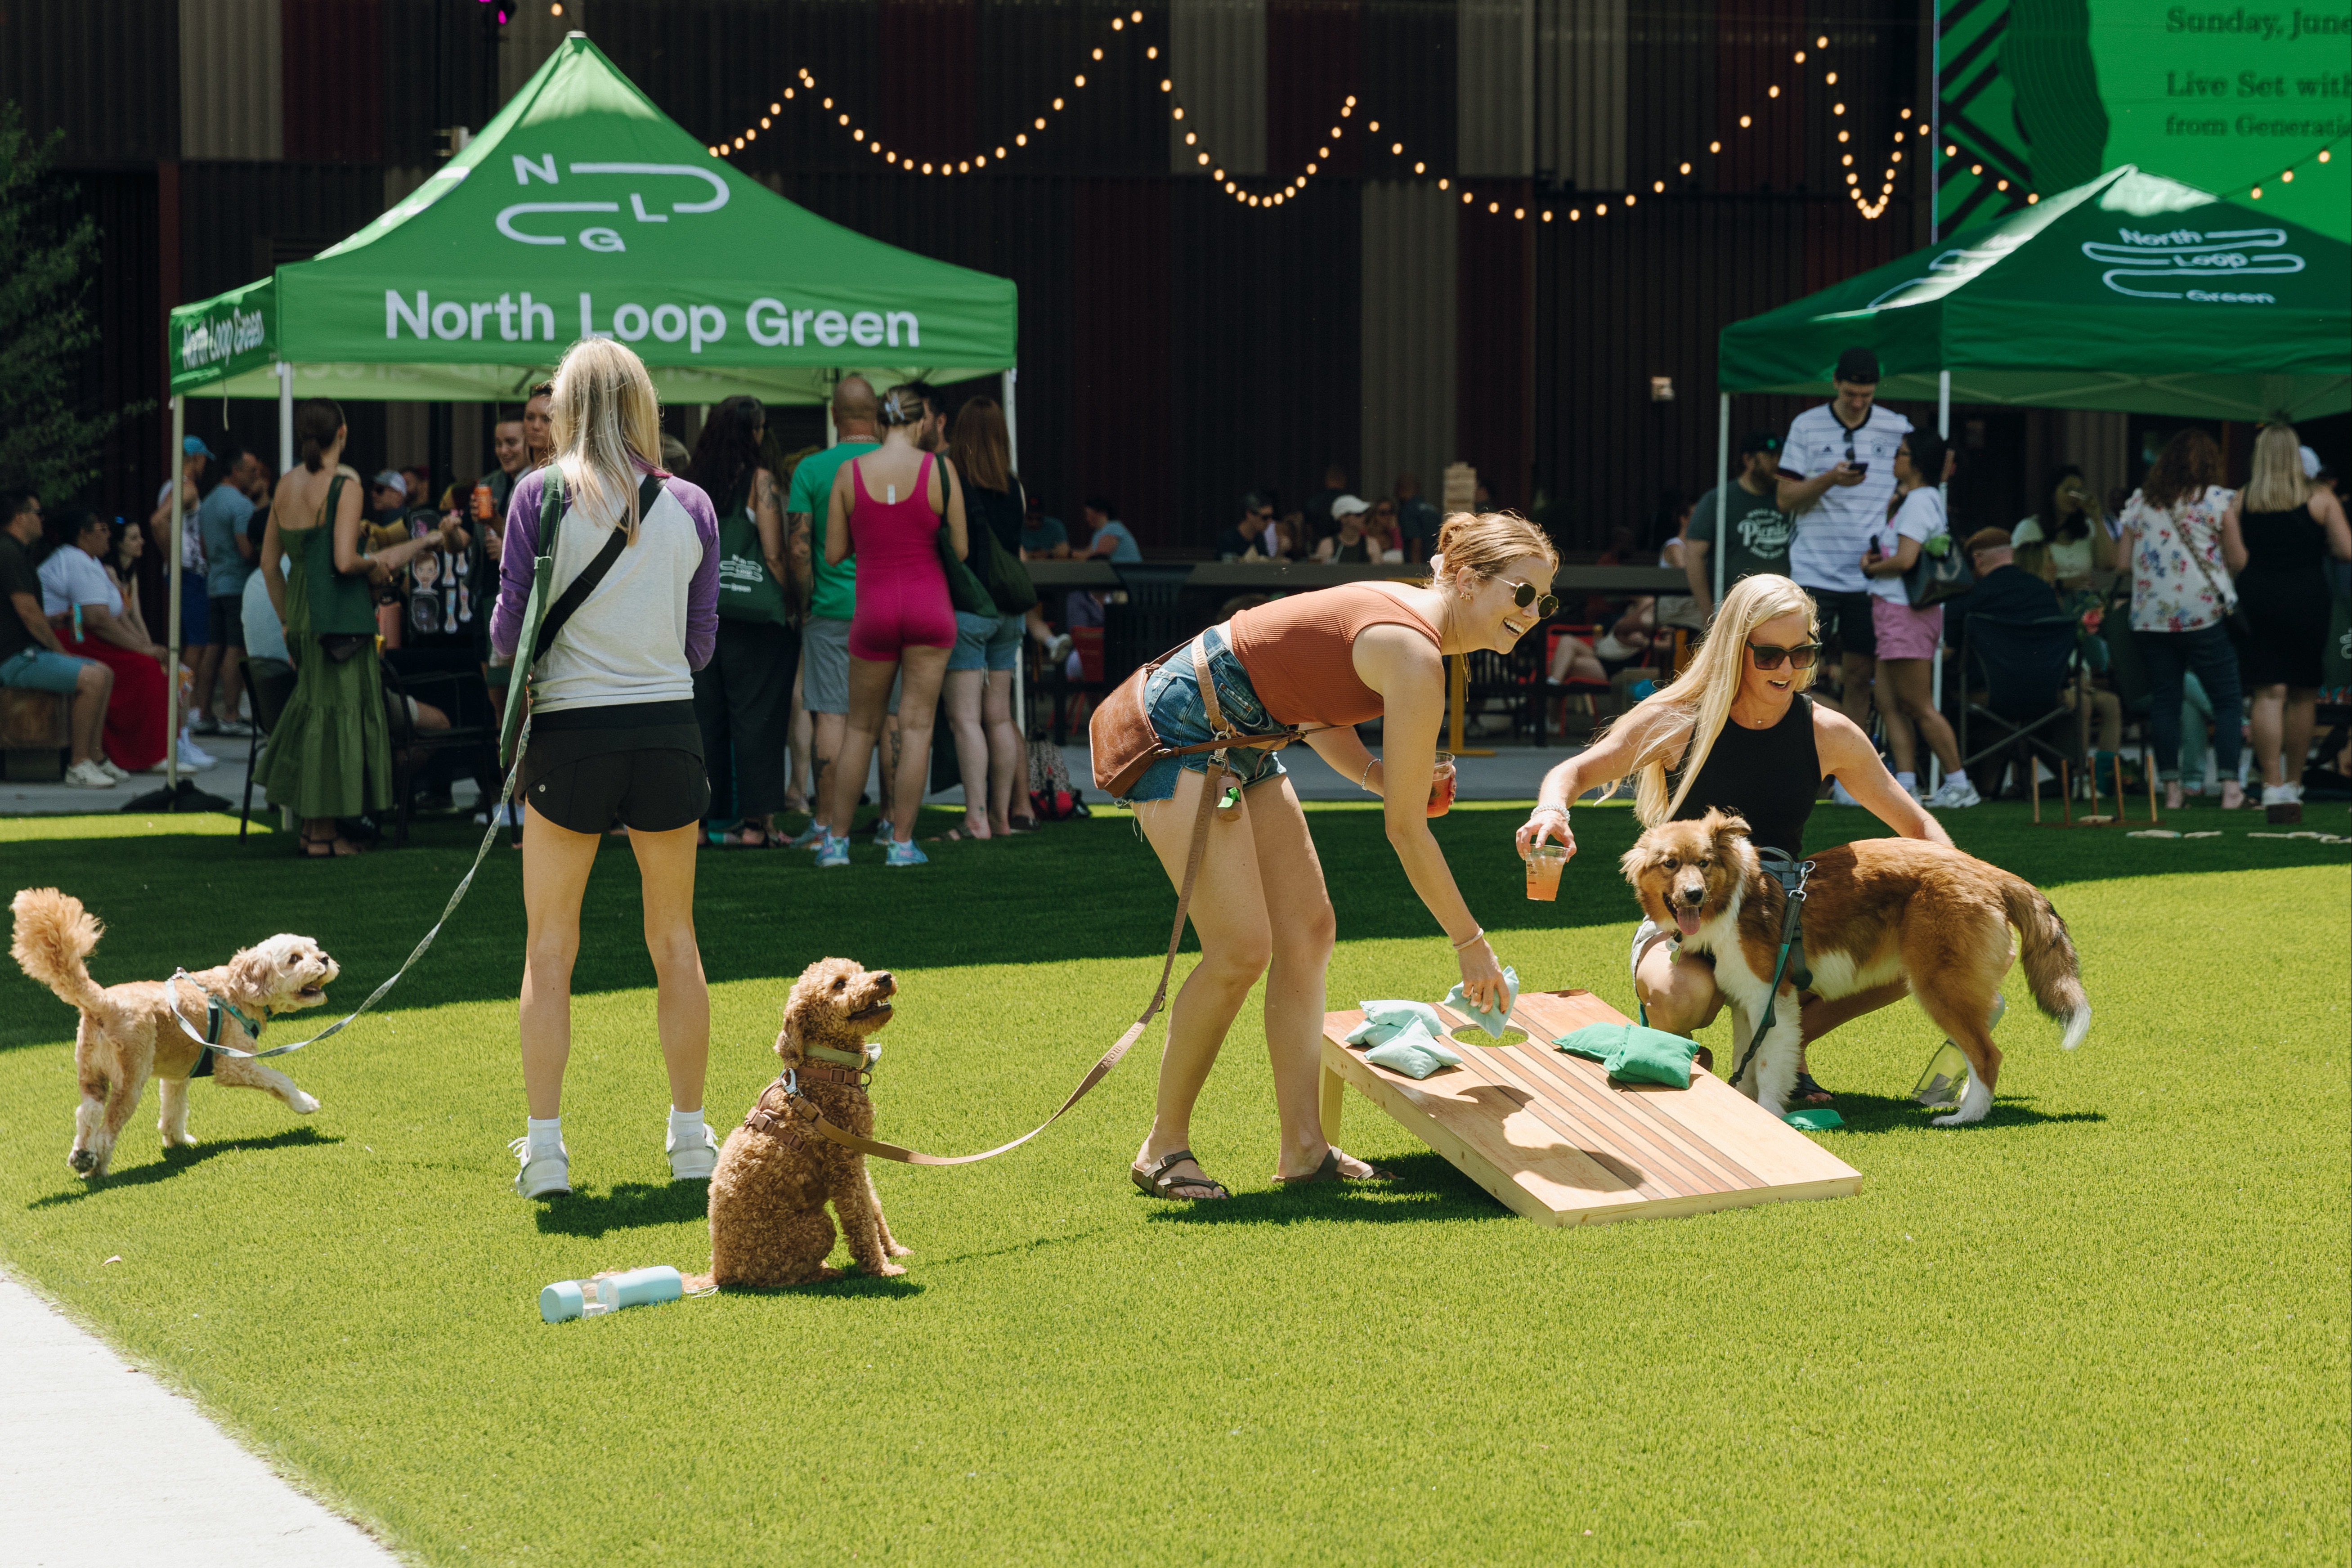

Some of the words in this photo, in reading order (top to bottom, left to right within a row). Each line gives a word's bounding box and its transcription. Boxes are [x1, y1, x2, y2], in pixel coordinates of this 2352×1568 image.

[2166, 6, 2285, 40] Sunday,
[2166, 70, 2228, 96] Live
[2236, 70, 2284, 98] Set
[2166, 112, 2227, 135] from
[512, 154, 559, 184] N
[631, 193, 668, 222] L
[578, 228, 626, 252] G
[2119, 228, 2203, 246] North
[2173, 254, 2248, 268] Loop
[2185, 289, 2276, 304] Green
[385, 289, 555, 340] North
[579, 292, 727, 354] Loop
[745, 297, 920, 347] Green
